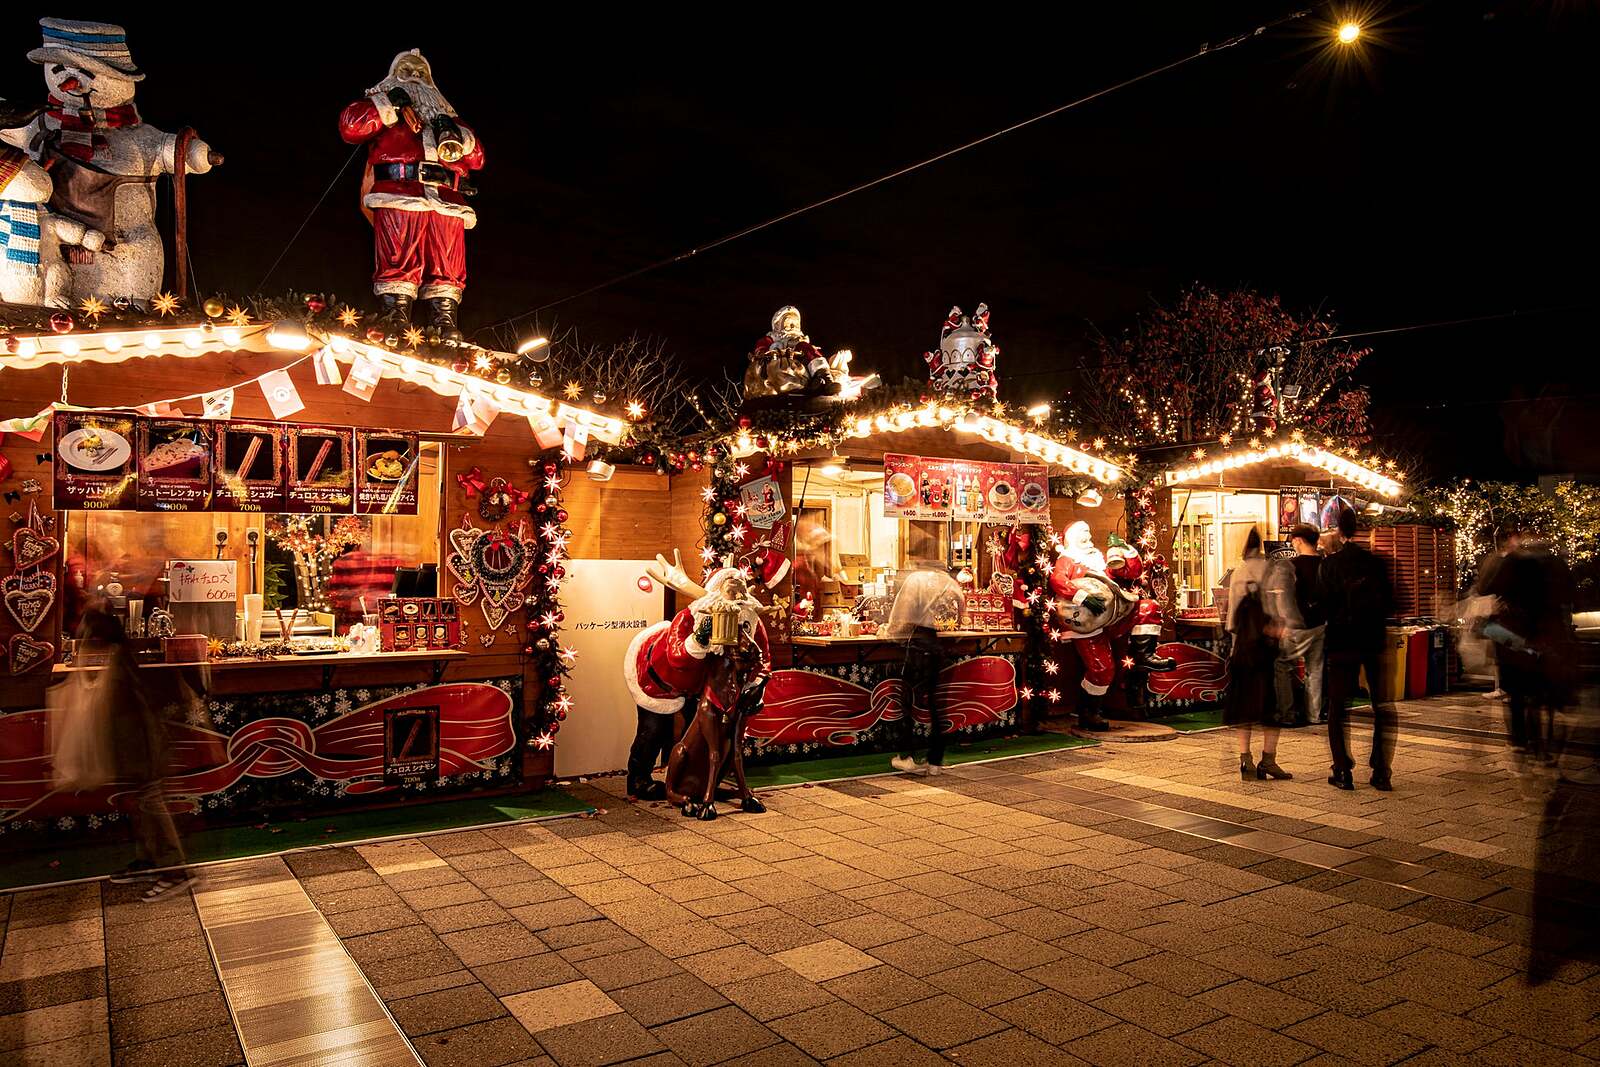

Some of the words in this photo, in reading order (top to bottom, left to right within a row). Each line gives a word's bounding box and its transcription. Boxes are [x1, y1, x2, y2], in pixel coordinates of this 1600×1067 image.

[66, 486, 123, 495] ザッハトルテ
[139, 488, 185, 497] シュトーレン
[187, 488, 209, 497] カット
[216, 489, 248, 498] チュロス
[250, 490, 282, 499] シュガー
[289, 491, 321, 500] チュロス
[321, 493, 351, 502] シナモン
[83, 501, 109, 509] 900円
[239, 503, 261, 512] 700円
[311, 505, 331, 513] 700円
[179, 572, 230, 585] 折れチュロス
[206, 588, 235, 600] 600円
[575, 619, 648, 630] パッケージ型消火設備
[385, 766, 411, 775] チュロス
